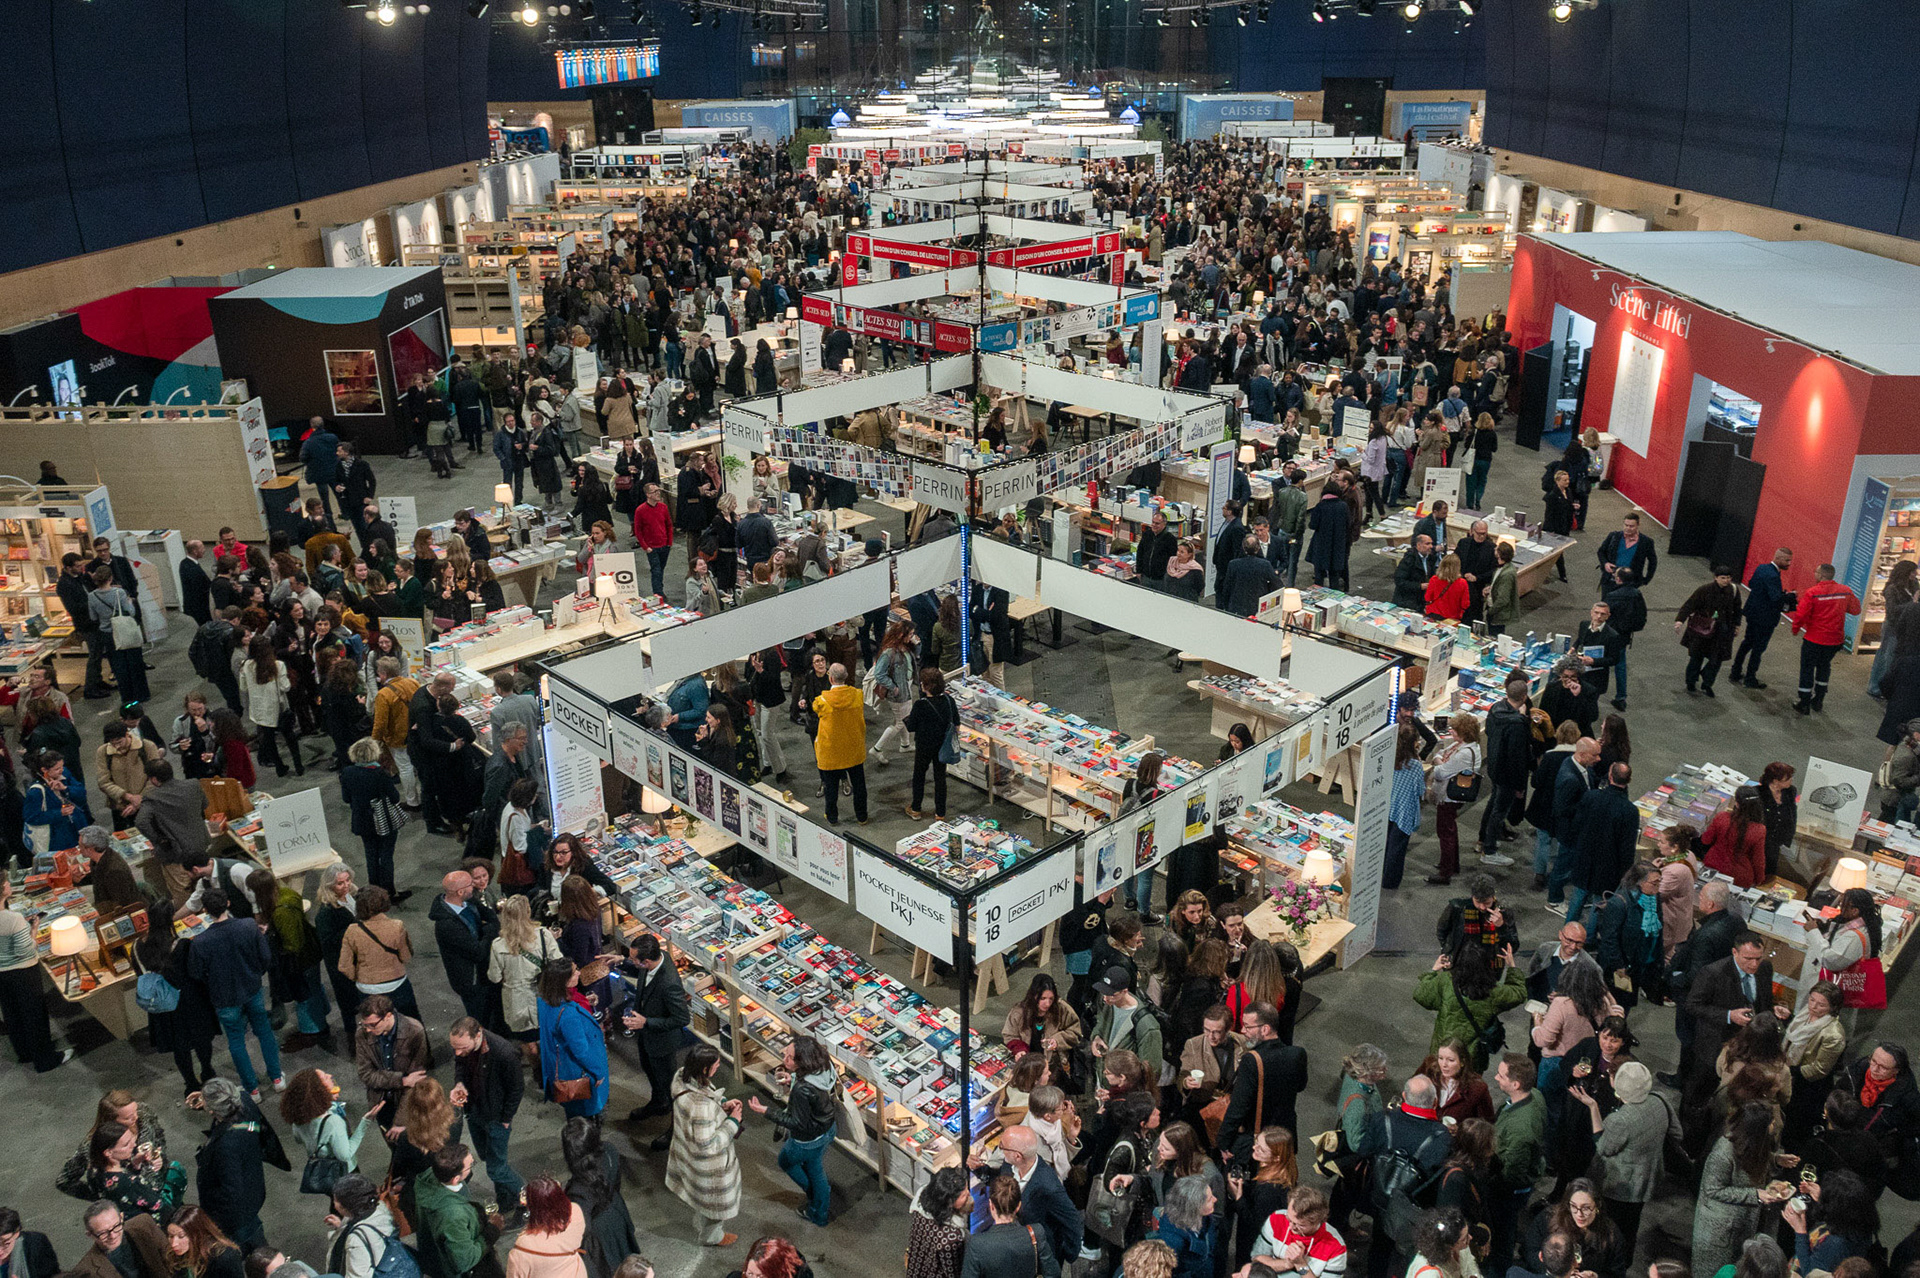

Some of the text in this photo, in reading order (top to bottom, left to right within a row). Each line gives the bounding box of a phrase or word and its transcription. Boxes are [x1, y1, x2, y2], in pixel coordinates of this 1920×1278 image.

[704, 112, 754, 122] CAISSES
[1220, 106, 1271, 116] CAISSES
[1424, 106, 1461, 114] Boutique
[344, 237, 366, 262] Stock
[874, 245, 890, 254] BESOIN
[900, 248, 920, 258] CONSEIL
[926, 252, 945, 261] LECTURE
[1016, 253, 1034, 262] BESOIN
[1045, 250, 1063, 258] CONSEIL
[1070, 245, 1088, 253] LECTURE
[804, 306, 830, 318] ACTES SUD
[865, 314, 900, 328] ACTES SUD
[1654, 300, 1692, 340] Eiffel
[938, 334, 969, 345] ACTES SUD
[1204, 424, 1222, 436] Laffont
[1205, 416, 1223, 426] Robert
[725, 420, 763, 444] PERRIN
[914, 476, 964, 502] PERRIN
[985, 473, 1034, 501] PERRIN
[1338, 703, 1352, 725] 10
[1361, 700, 1375, 713] monde
[556, 702, 600, 738] POCKET
[1336, 727, 1350, 749] 18
[810, 862, 819, 870] pour
[820, 868, 829, 876] vous
[830, 872, 840, 880] tenir
[860, 870, 946, 924] POCKET JEUNESSE
[985, 905, 1001, 924] 10
[1012, 896, 1041, 918] POCKET
[985, 924, 1000, 943] 18
